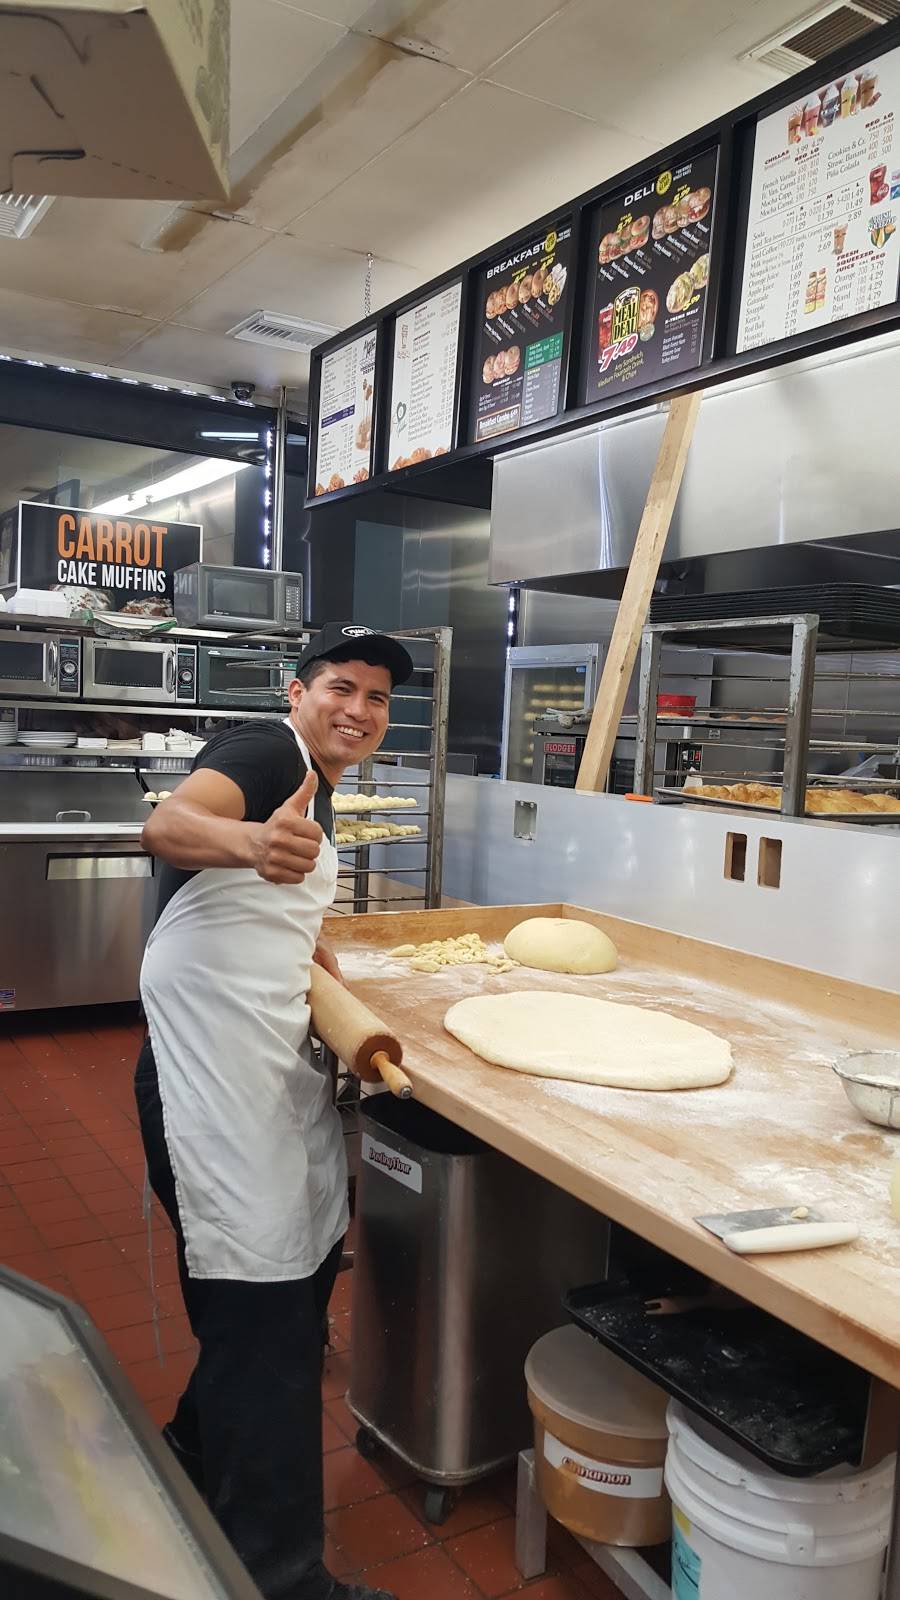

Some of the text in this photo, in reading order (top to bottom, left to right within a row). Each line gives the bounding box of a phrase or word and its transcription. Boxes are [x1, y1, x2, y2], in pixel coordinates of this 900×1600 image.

[827, 143, 850, 160] Cookies
[845, 146, 866, 161] Banana
[839, 158, 859, 173] Colada
[762, 177, 778, 190] French
[624, 183, 655, 207] DELI
[847, 209, 862, 222] 2.89
[752, 229, 765, 240] Soda
[819, 230, 831, 241] 1.99
[486, 242, 545, 280] BREAKFAST
[836, 249, 859, 261] FRESH
[836, 249, 873, 267] SQUEEZED
[835, 263, 855, 273] JUICE
[833, 282, 851, 293] Carrot
[869, 270, 883, 282] 4.29
[834, 270, 855, 284] Orange
[832, 292, 850, 303] Mixed
[615, 302, 637, 324] MEAL
[832, 302, 843, 312] Red
[614, 319, 637, 341] DEAL
[600, 333, 639, 373] 7.49
[58, 514, 168, 569] CARROT
[57, 560, 166, 593] CAKE MUFFINS
[561, 1456, 632, 1486] Cinnamon
